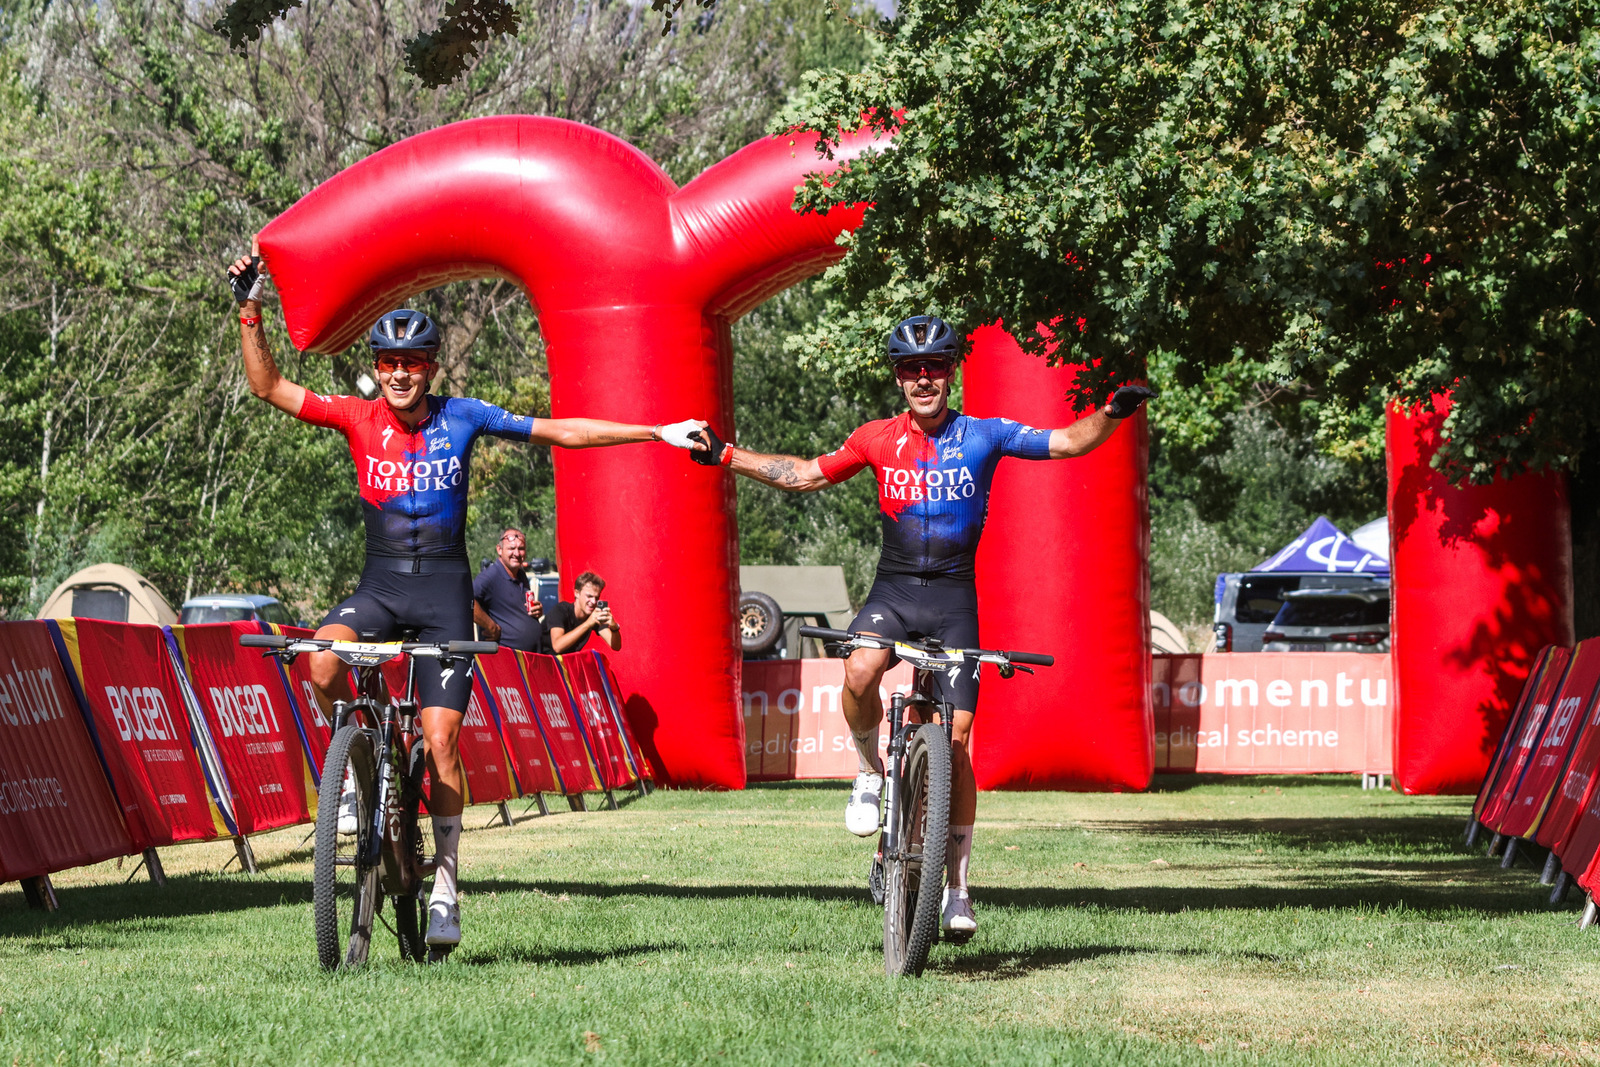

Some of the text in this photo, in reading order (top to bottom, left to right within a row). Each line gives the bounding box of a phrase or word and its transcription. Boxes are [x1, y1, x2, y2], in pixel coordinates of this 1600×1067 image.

[366, 455, 462, 478] TOYOTA
[882, 466, 974, 487] TOYOTA
[367, 471, 463, 492] IMBUKO
[884, 482, 975, 502] IMBUKO
[1154, 723, 1338, 748] edical scheme
